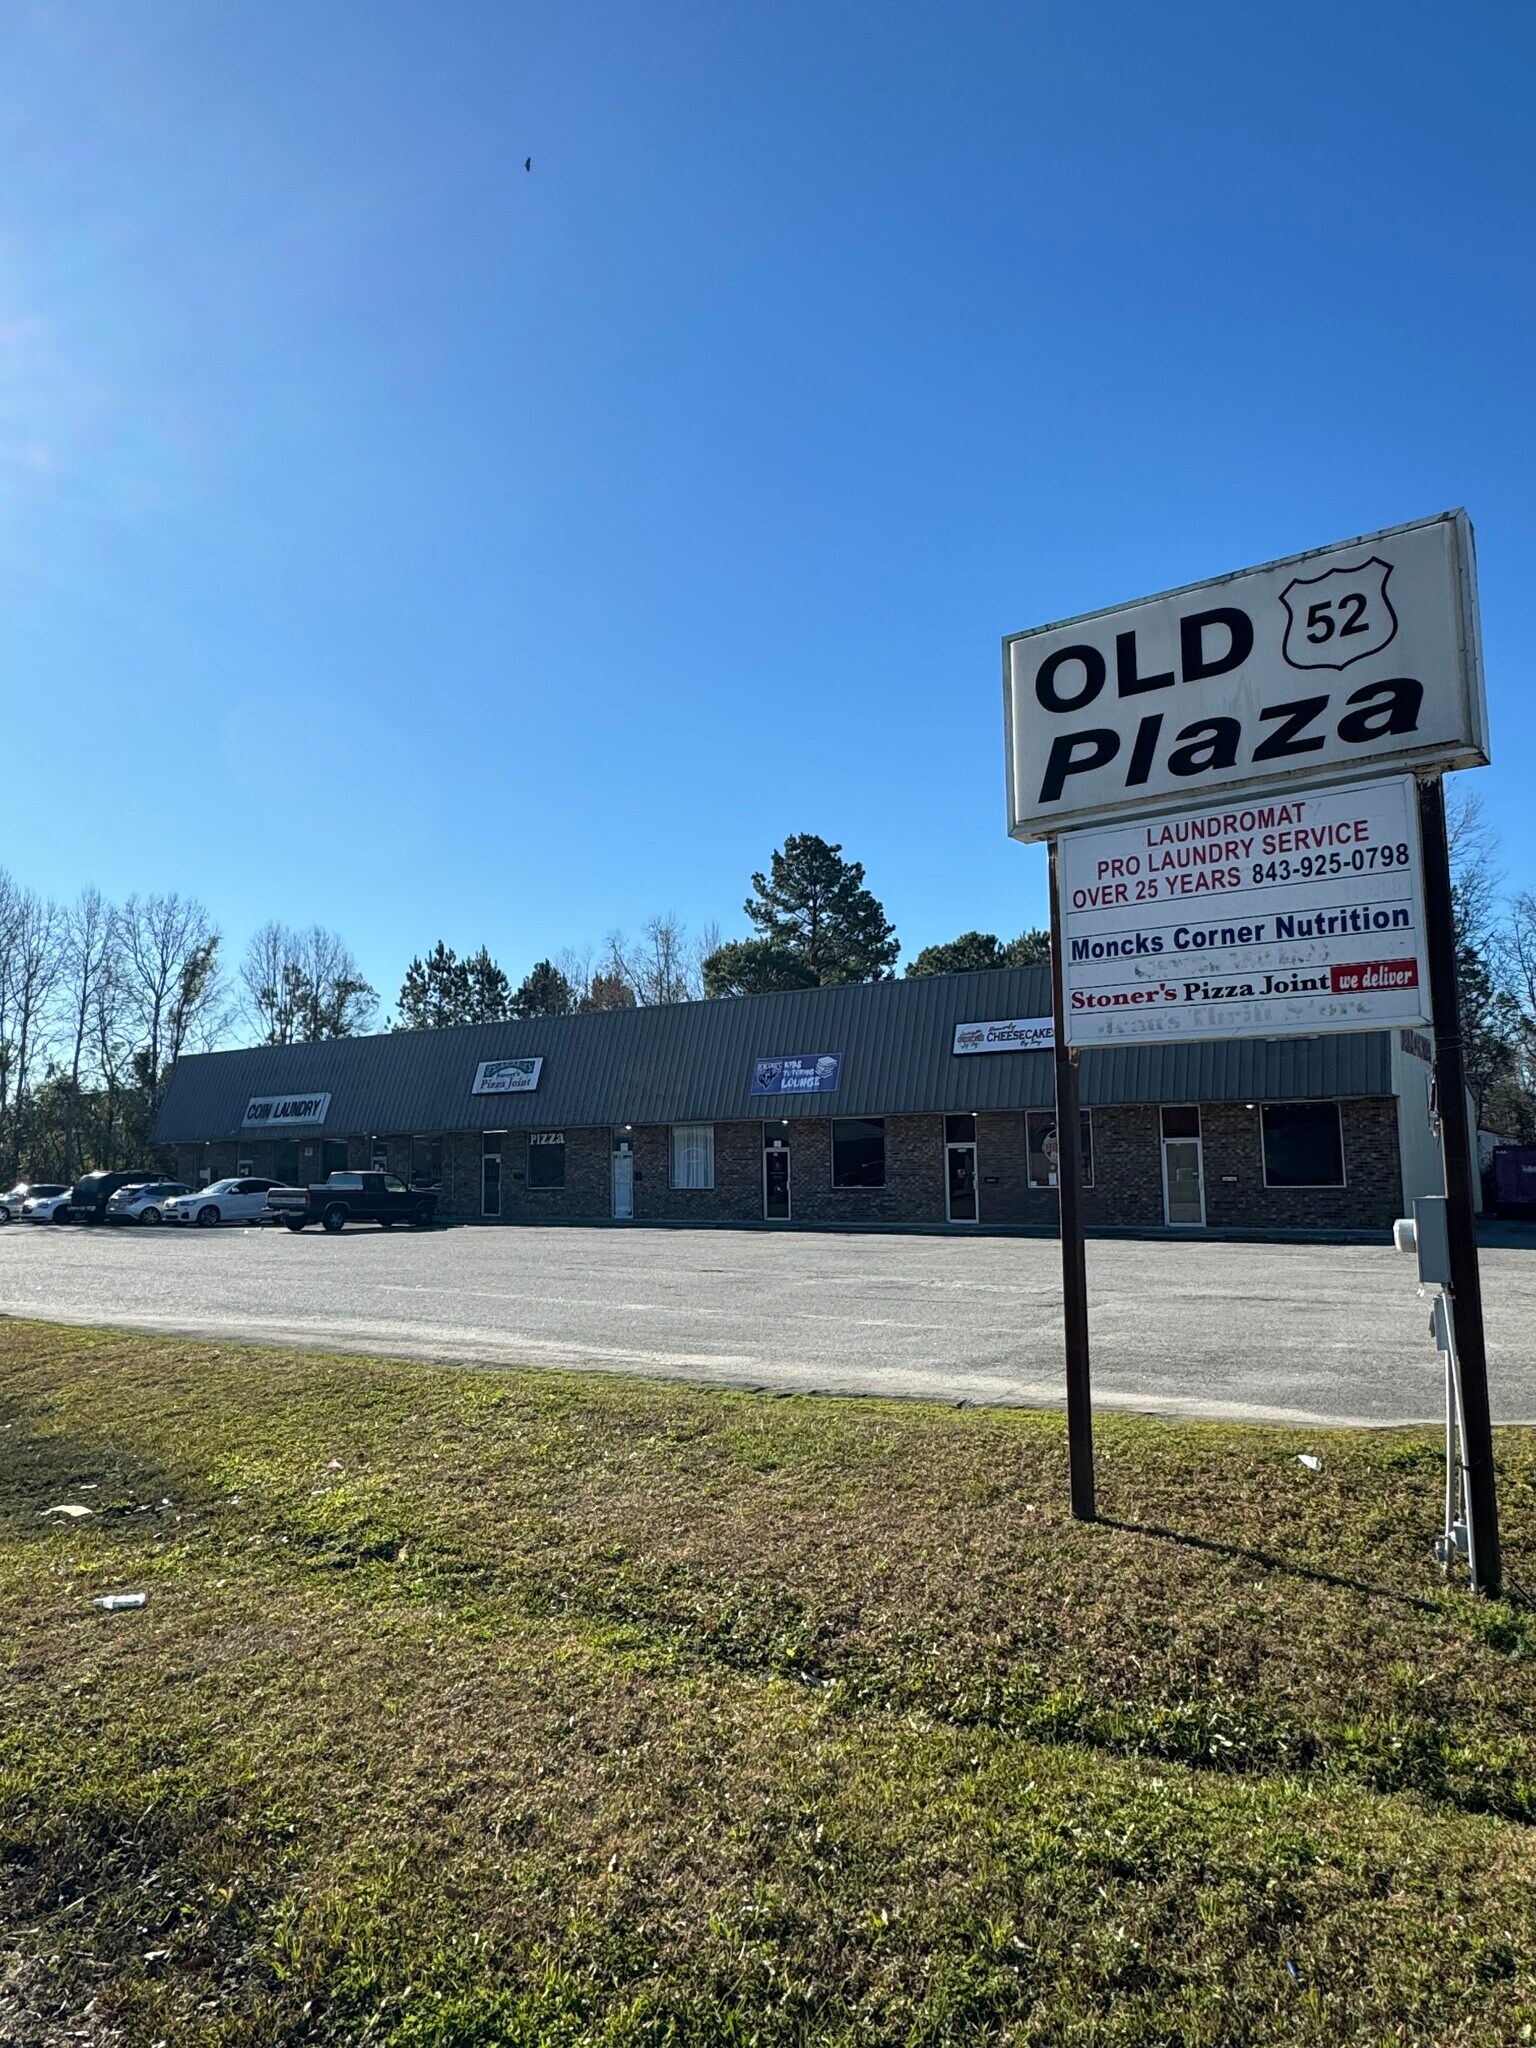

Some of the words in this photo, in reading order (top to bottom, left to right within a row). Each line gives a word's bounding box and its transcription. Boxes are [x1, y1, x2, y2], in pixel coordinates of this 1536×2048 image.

[1306, 593, 1369, 644] 52
[1035, 607, 1254, 713] OLD
[1038, 677, 1424, 803] Plaza
[1147, 802, 1306, 847] LAUNDROMAT
[1098, 856, 1140, 880] PRO
[1148, 837, 1254, 872] LAUNDRY
[1262, 820, 1369, 855] SERVICE
[1073, 883, 1129, 909] OVER
[1135, 879, 1158, 900] 25
[1165, 867, 1241, 895] YEARS
[1252, 843, 1409, 884] 843-925-0798
[1072, 933, 1163, 960] Moncks
[1174, 924, 1265, 949] Corner
[1275, 907, 1410, 939] Nutrition
[1071, 983, 1177, 1009] Stoner's
[1183, 982, 1255, 1001] Pizza
[1259, 973, 1330, 995] Joint
[1339, 974, 1358, 989] we
[1362, 965, 1412, 988] deliver
[986, 1027, 1055, 1042] CHEESECAKE
[505, 1077, 531, 1090] Joint
[781, 1076, 820, 1088] LOUNGE
[273, 1099, 321, 1119] LAUNDRY
